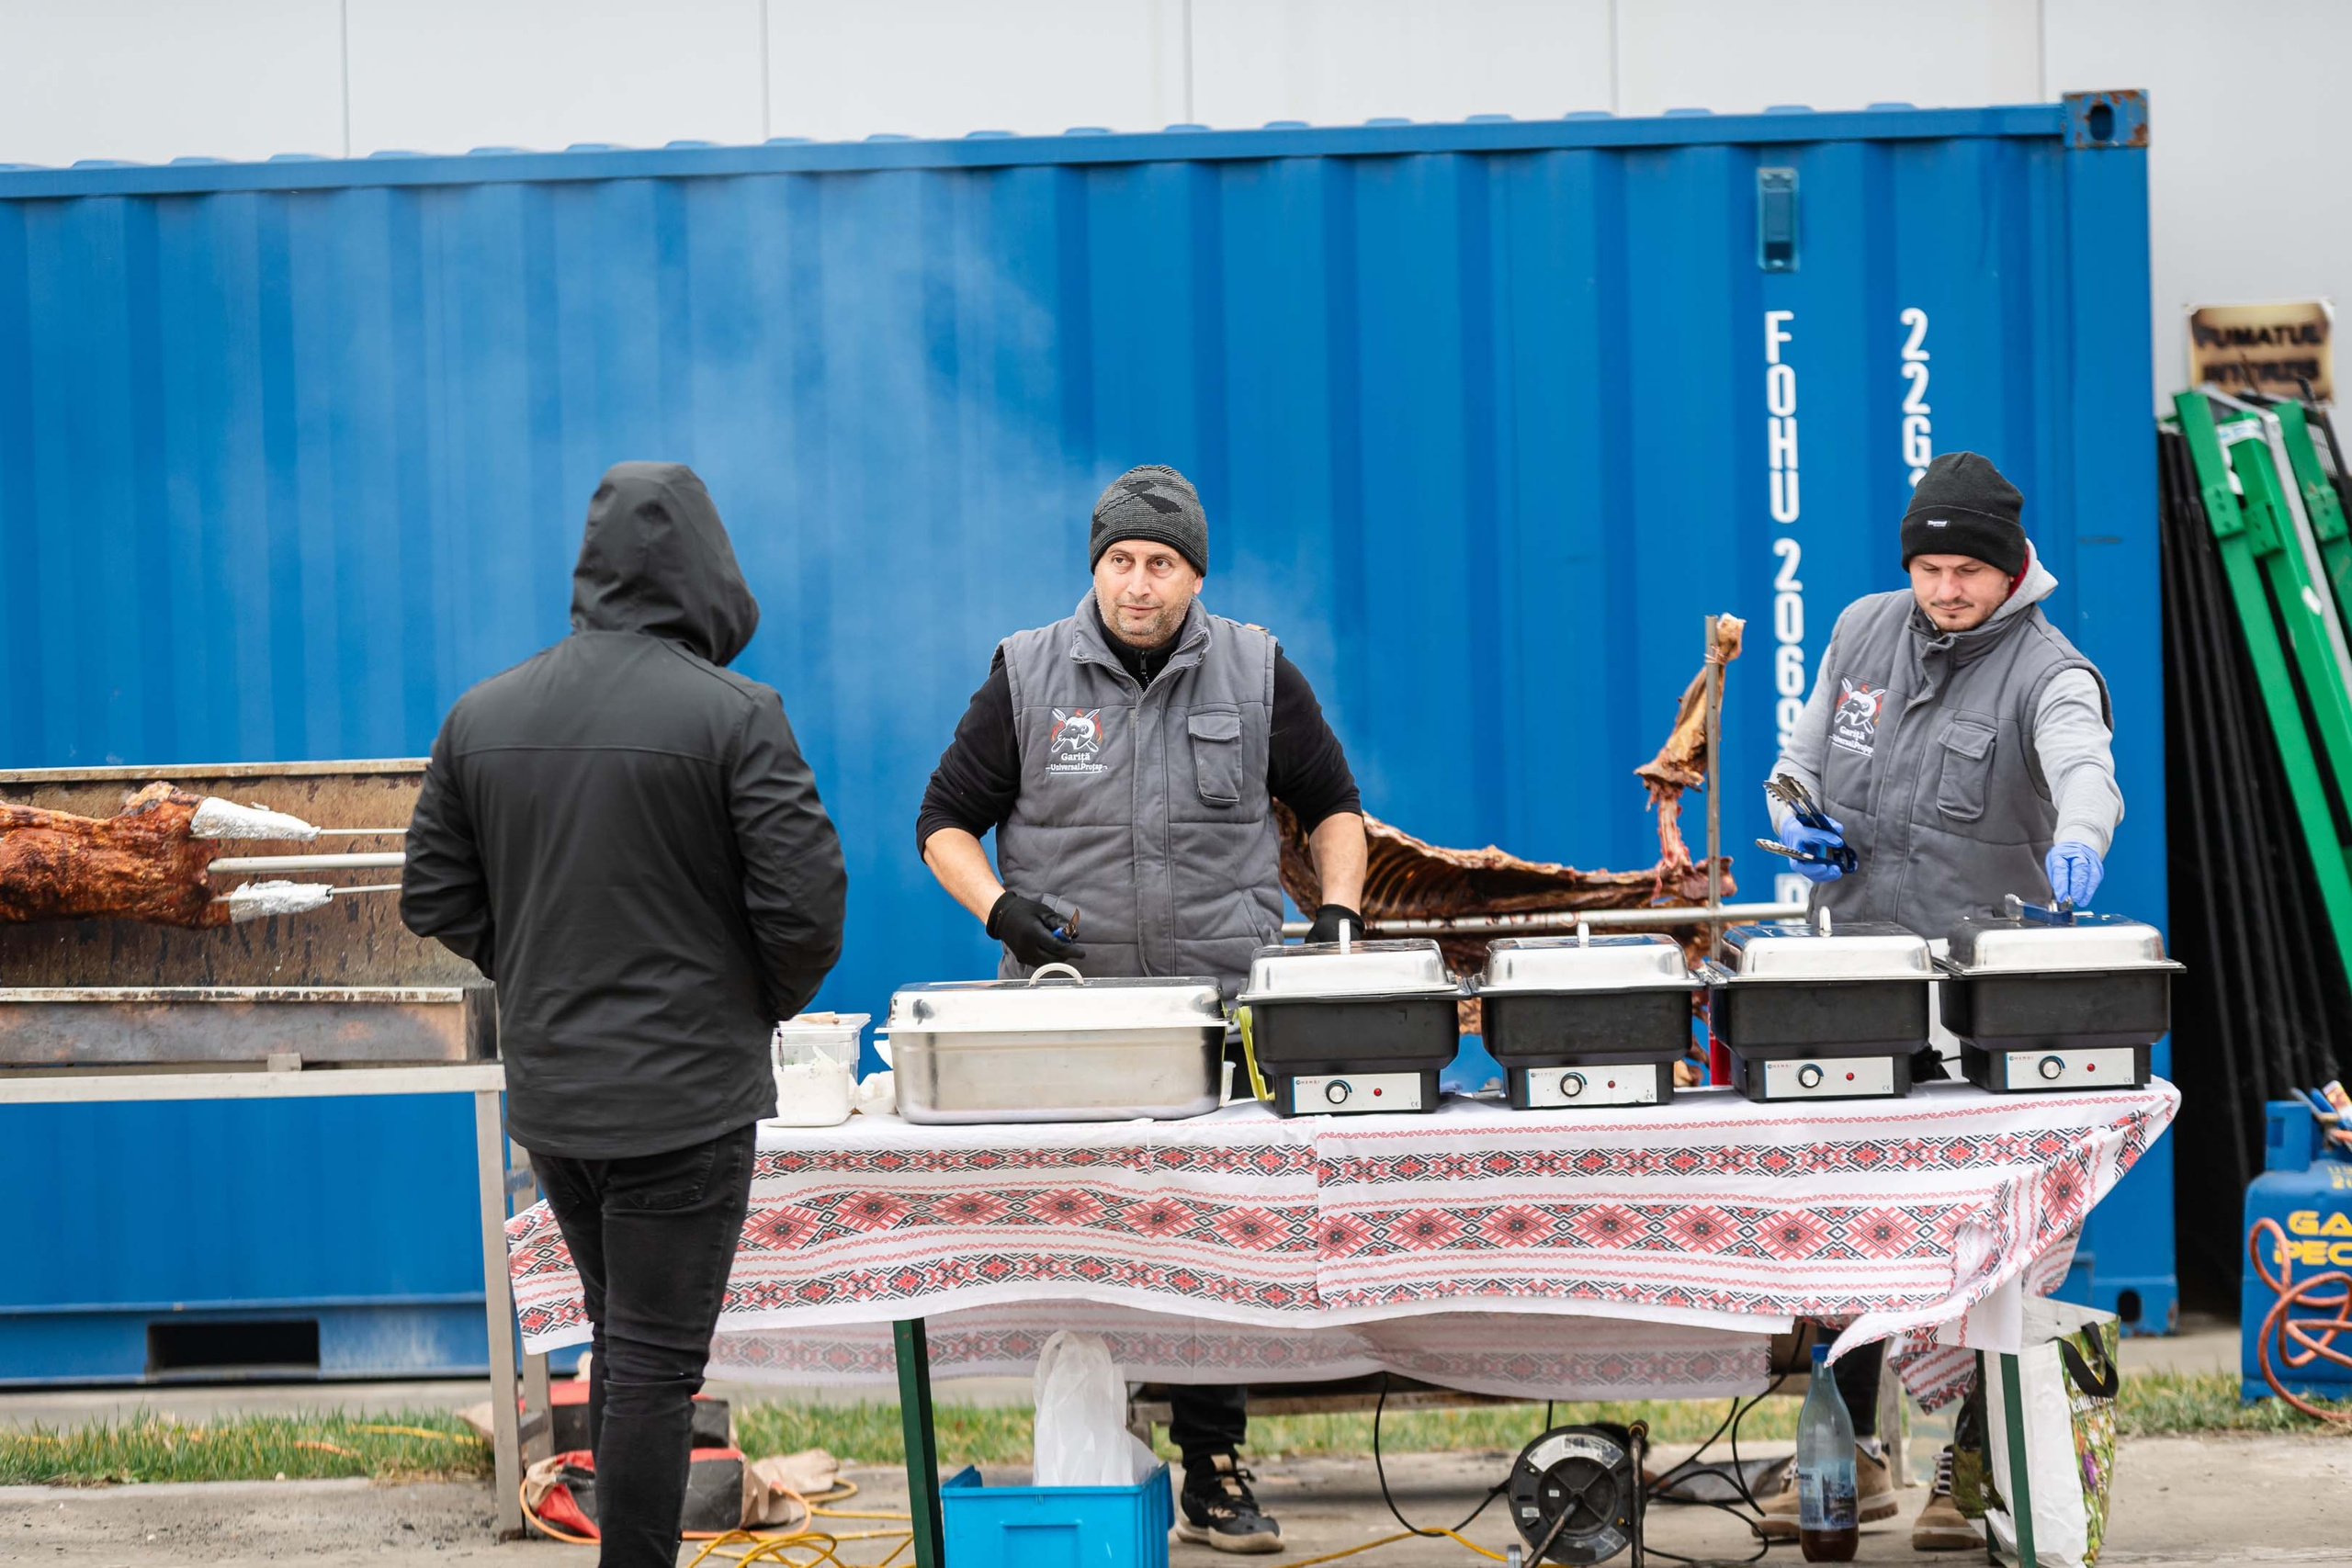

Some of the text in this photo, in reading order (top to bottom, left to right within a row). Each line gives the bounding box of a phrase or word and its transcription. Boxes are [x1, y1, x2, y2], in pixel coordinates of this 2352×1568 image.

[1900, 307, 1932, 488] 22G
[1765, 310, 1805, 755] FOHU 2069
[1050, 762, 1080, 772] Universal
[2288, 1210, 2352, 1236] GA
